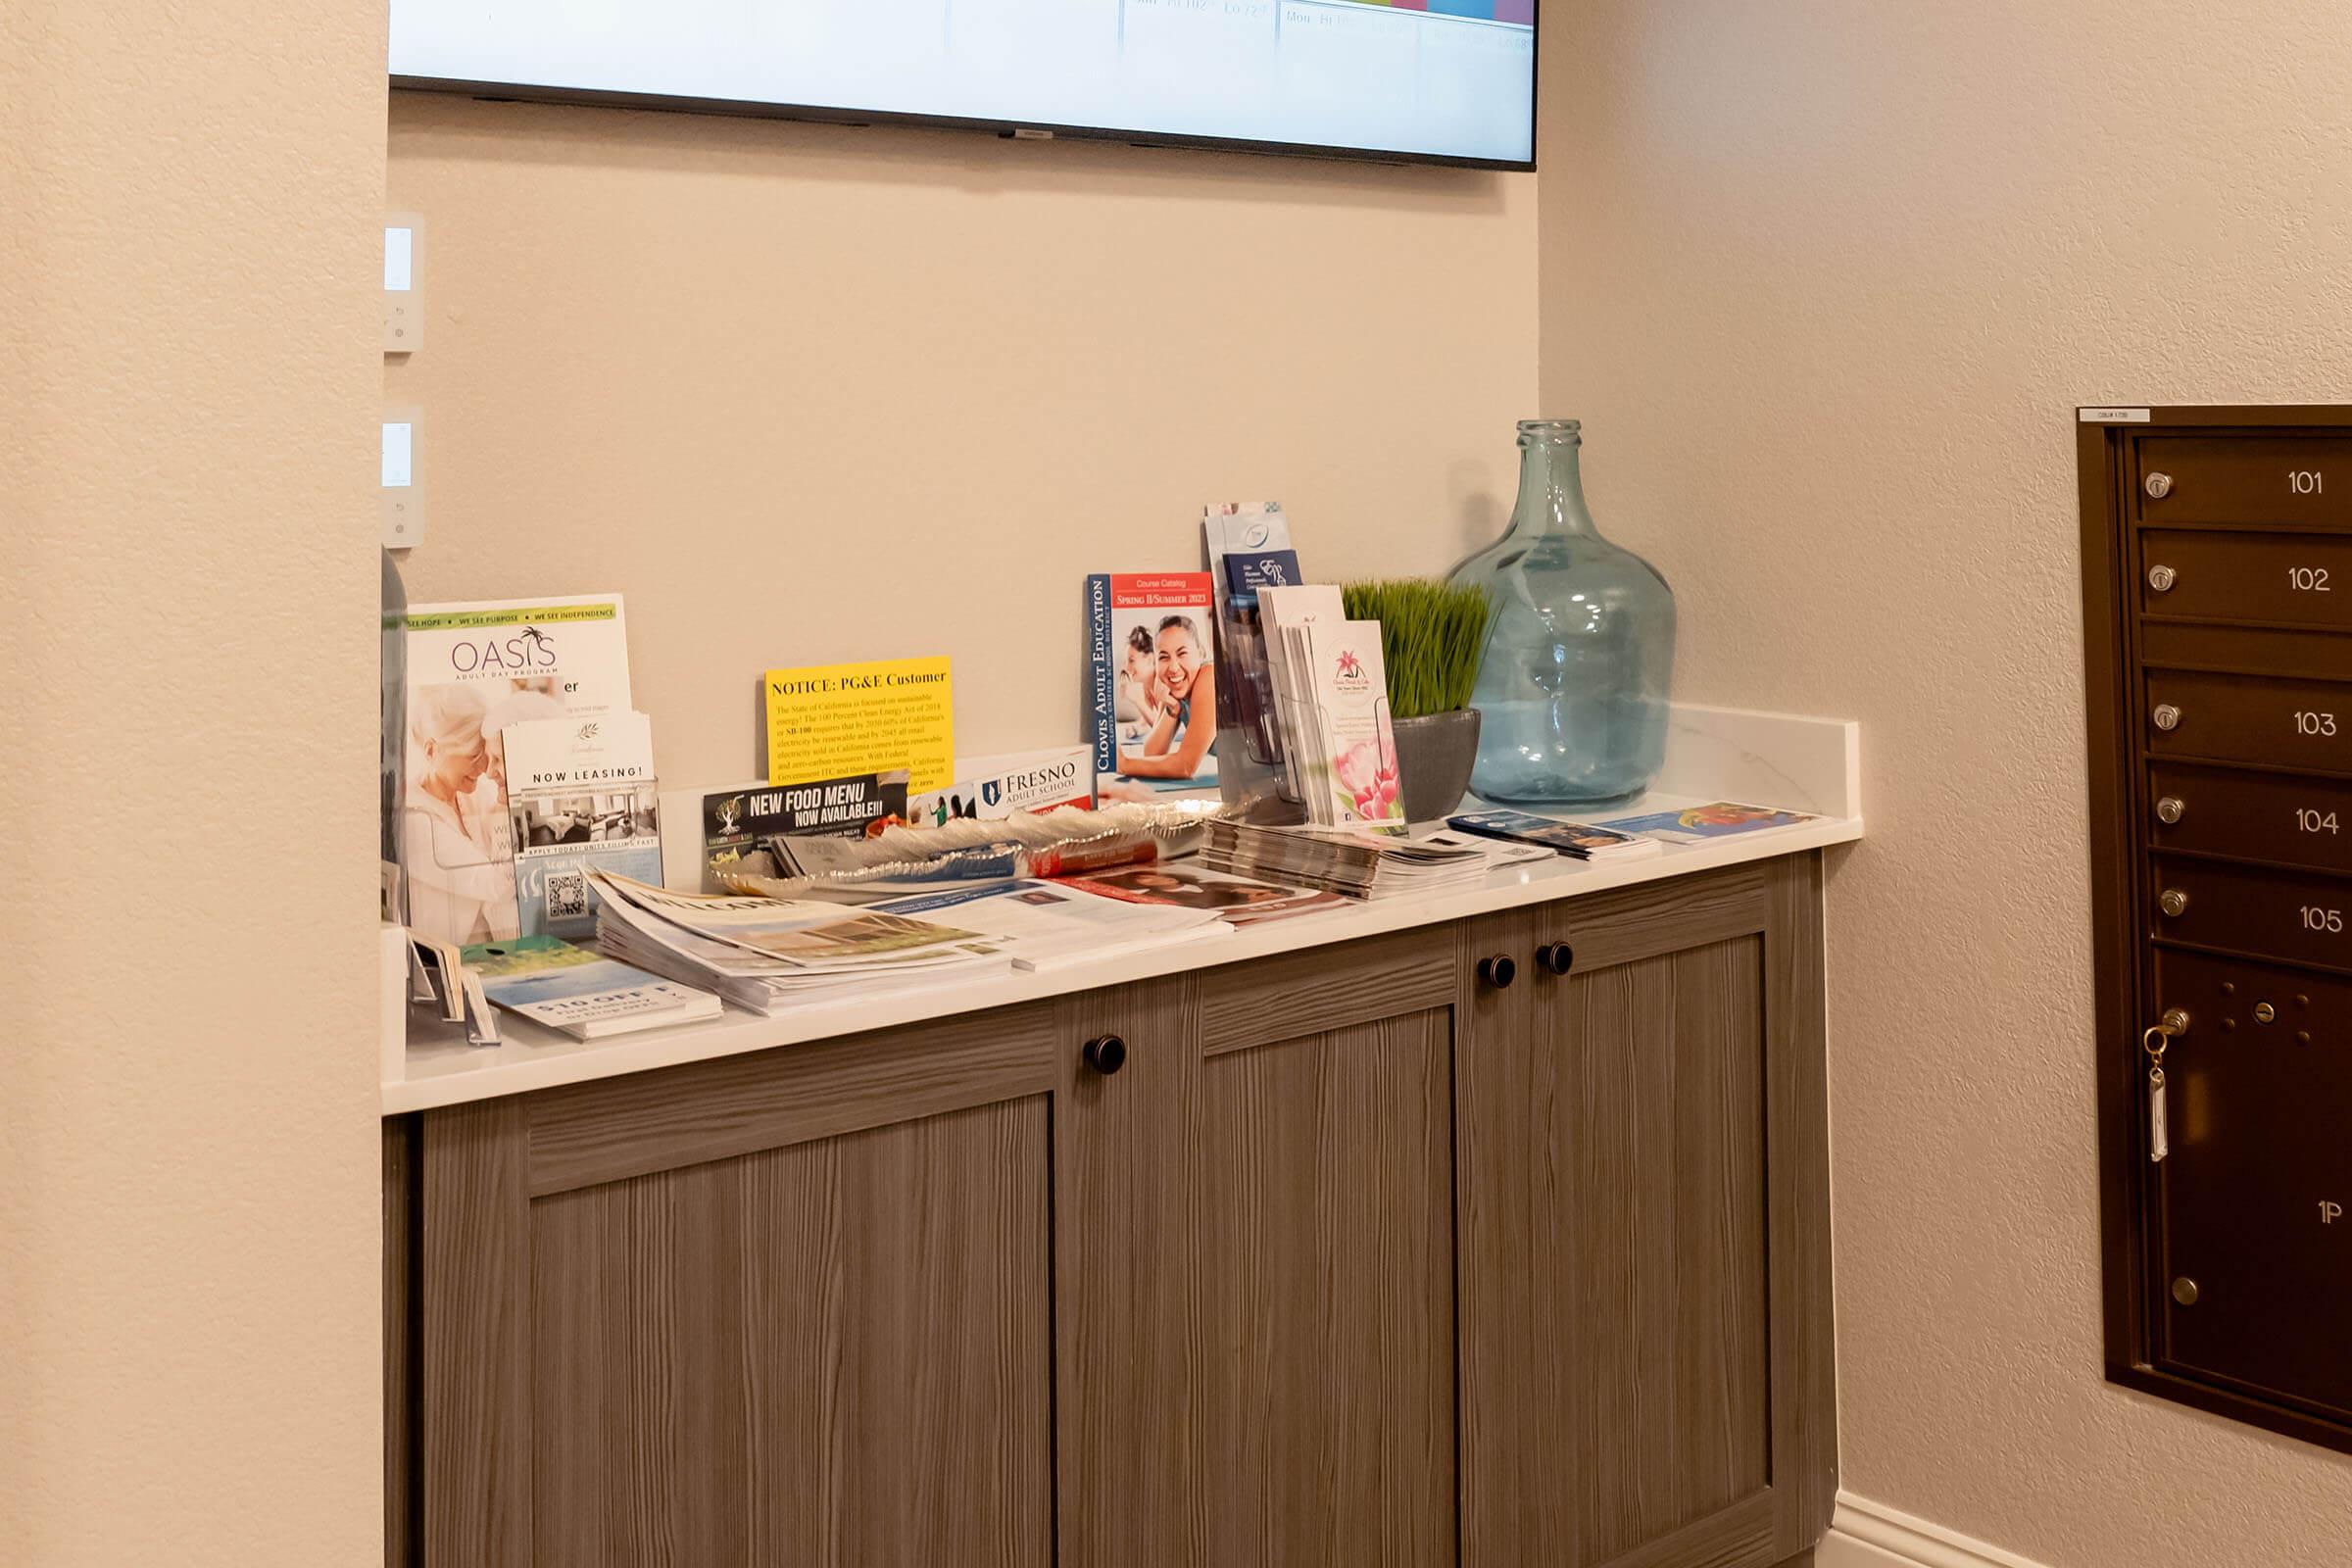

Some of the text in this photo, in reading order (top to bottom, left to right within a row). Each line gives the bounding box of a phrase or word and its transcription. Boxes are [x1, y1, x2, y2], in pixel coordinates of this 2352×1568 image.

[2288, 470, 2323, 494] 101
[1161, 579, 1186, 588] Catalog
[2288, 567, 2330, 591] 102
[1189, 594, 1205, 603] 2023
[453, 637, 556, 671] OASIS
[772, 672, 946, 696] NOTICE: PG&E Customer
[1093, 580, 1109, 769] CLOVIS ADULT EDUCATION
[777, 706, 789, 714] The
[792, 704, 808, 712] State
[818, 700, 852, 710] California
[861, 697, 886, 706] focused
[897, 693, 932, 704] sustainable
[805, 714, 817, 723] The
[819, 712, 831, 721] 100
[833, 710, 858, 720] Percent
[859, 709, 878, 718] Clean
[880, 707, 902, 716] Energy
[926, 703, 941, 711] 2018
[900, 715, 907, 724] of
[908, 713, 944, 723] California's
[2294, 711, 2337, 737] 103
[777, 738, 809, 748] electricity
[823, 733, 855, 743] renewable
[871, 730, 879, 739] by
[777, 749, 810, 760] electricity
[837, 742, 869, 753] California
[894, 738, 908, 747] from
[910, 735, 943, 745] renewable
[867, 751, 883, 760] With
[885, 749, 908, 759] Federal
[913, 757, 945, 766] California
[533, 766, 642, 783] NOW LEASING!
[931, 766, 945, 775] with
[1007, 762, 1075, 793] FRESNO
[751, 783, 865, 816] NEW FOOD MENU
[1006, 787, 1036, 805] ADULT
[1040, 779, 1075, 794] SCHOOL
[796, 810, 819, 827] NOW
[2296, 808, 2339, 835] 104
[2300, 906, 2342, 933] 105
[2318, 1200, 2342, 1224] 1P
